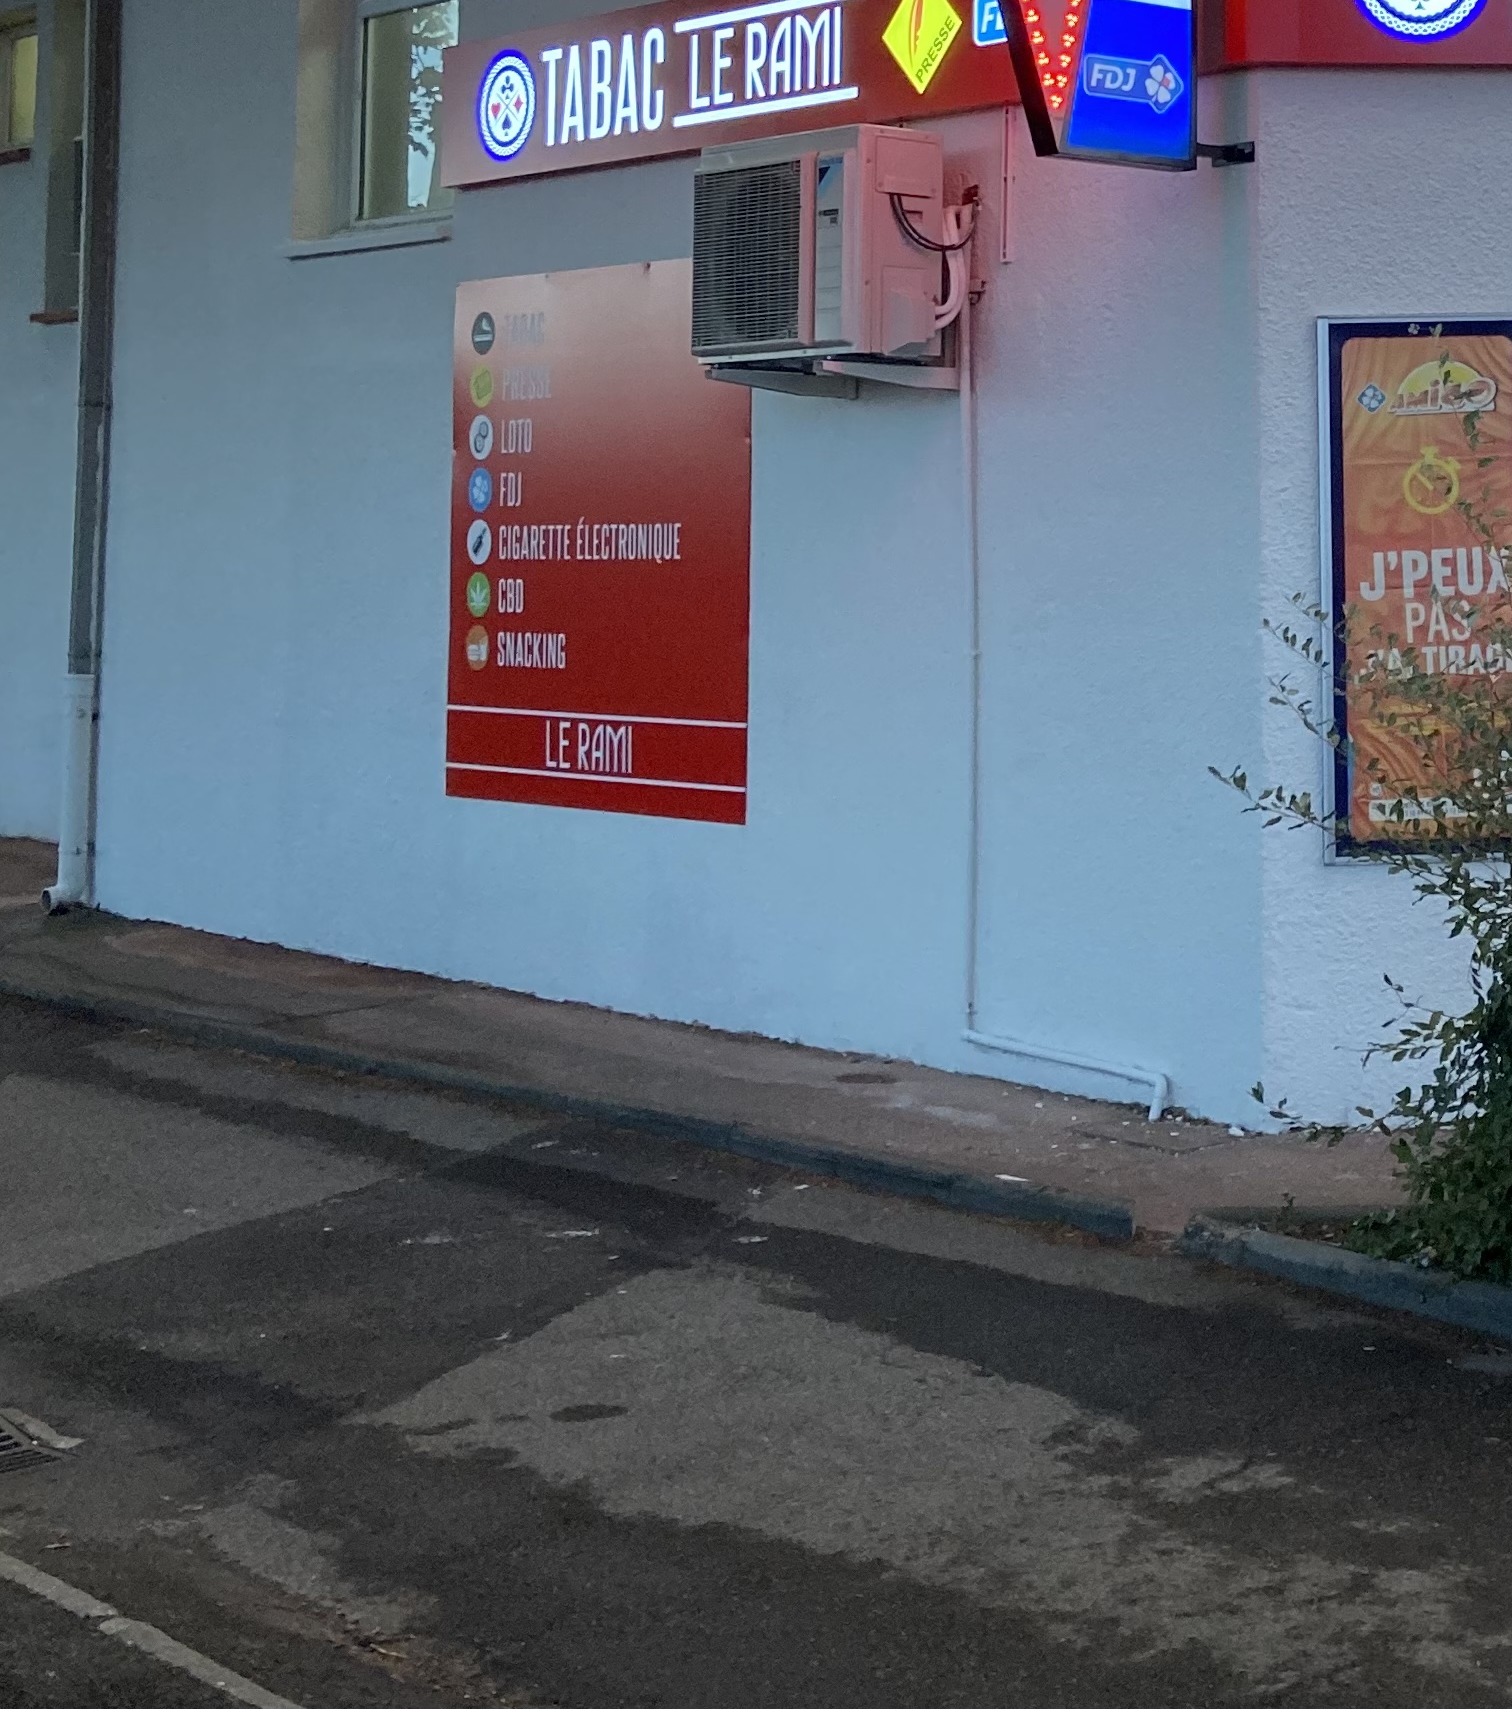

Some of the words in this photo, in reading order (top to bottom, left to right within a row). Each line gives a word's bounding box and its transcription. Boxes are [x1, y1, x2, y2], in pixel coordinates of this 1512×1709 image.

[915, 15, 956, 84] PRESSE
[541, 26, 665, 147] TABAC
[688, 25, 734, 108] LE
[744, 6, 842, 100] RAMI
[1091, 63, 1136, 92] FDJ
[501, 418, 533, 454] LOTO
[500, 472, 523, 507] FDJ
[499, 524, 572, 560] CIGARETTE
[576, 517, 682, 564] ÉLECTRONIQUE
[498, 578, 524, 613] CBD
[1359, 547, 1512, 600] J'PEUX
[1405, 600, 1472, 644] PAS
[497, 632, 566, 669] SNACKING
[545, 720, 571, 769] LE
[577, 722, 633, 774] RAMI
